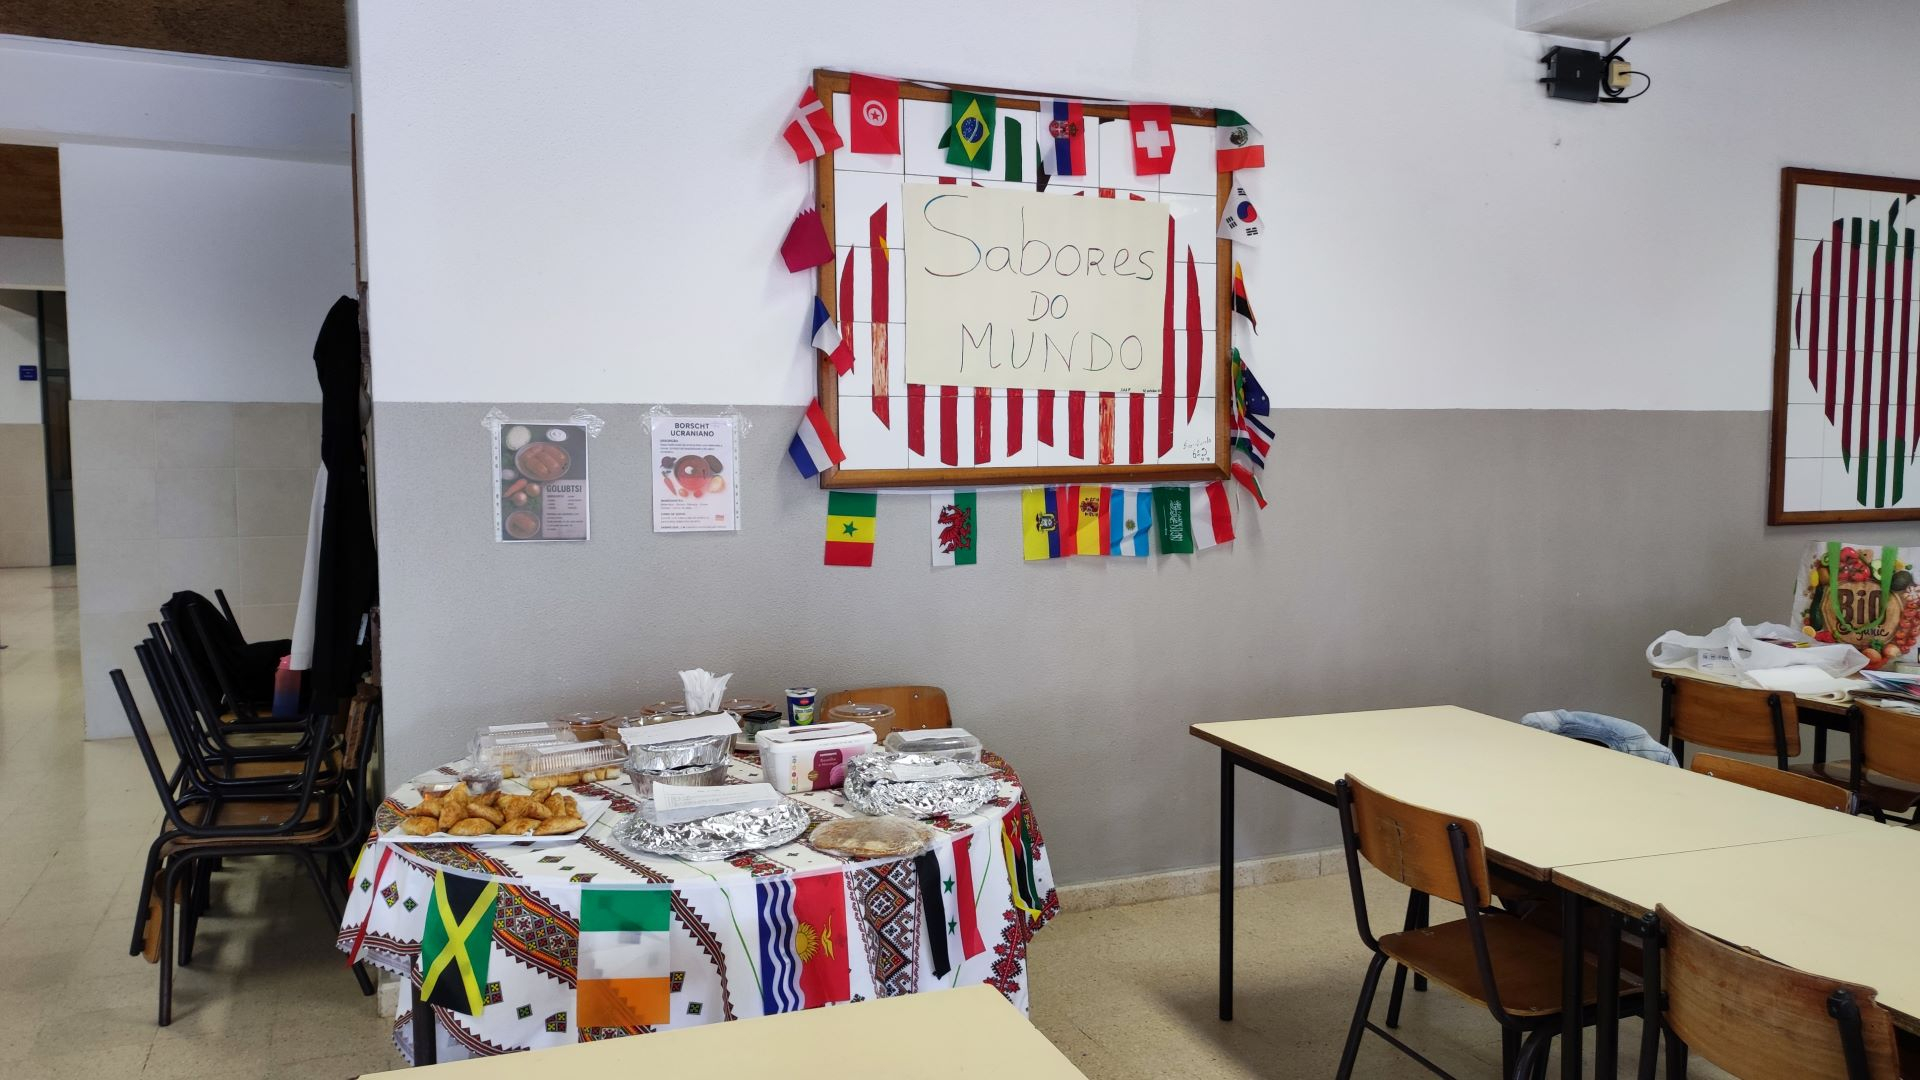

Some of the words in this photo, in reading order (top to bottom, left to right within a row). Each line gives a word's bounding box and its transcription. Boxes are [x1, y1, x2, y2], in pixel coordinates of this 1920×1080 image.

[1027, 290, 1069, 322] DO
[960, 322, 1143, 374] MUNDO
[674, 422, 710, 430] BORSCHT
[546, 484, 583, 493] GOLUBTSI
